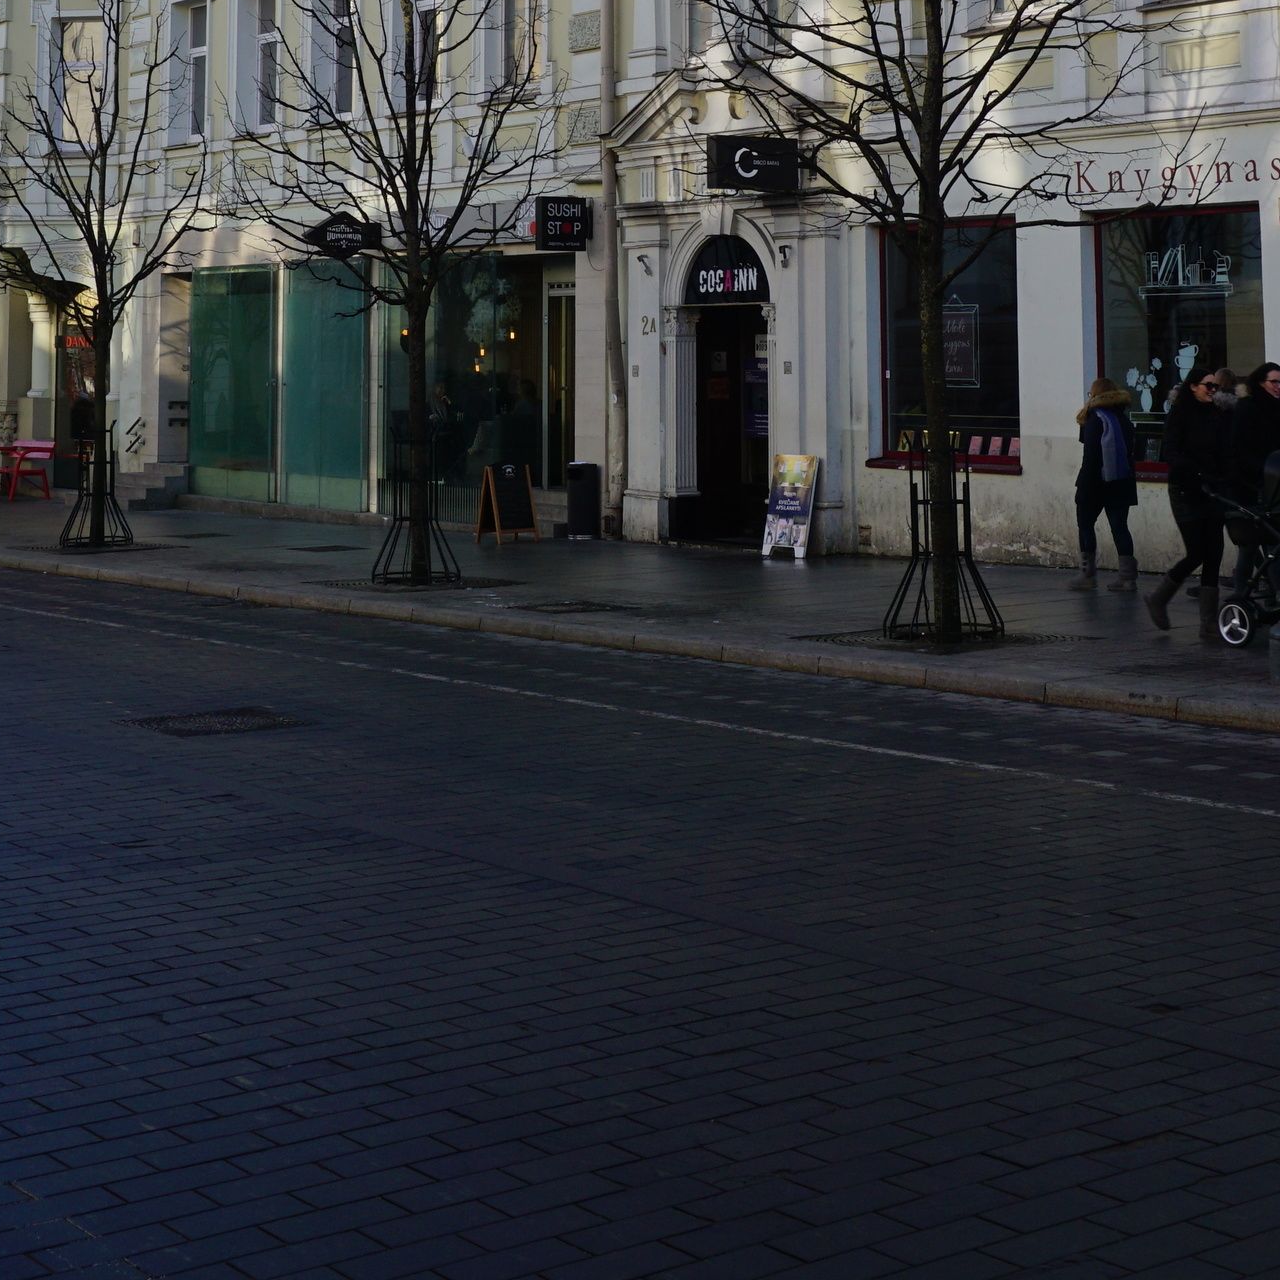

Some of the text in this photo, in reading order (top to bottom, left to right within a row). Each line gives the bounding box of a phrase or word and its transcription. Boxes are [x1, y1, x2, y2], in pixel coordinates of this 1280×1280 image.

[547, 202, 582, 218] SUSHI
[699, 264, 758, 293] COCAINN
[944, 339, 970, 355] nygoms
